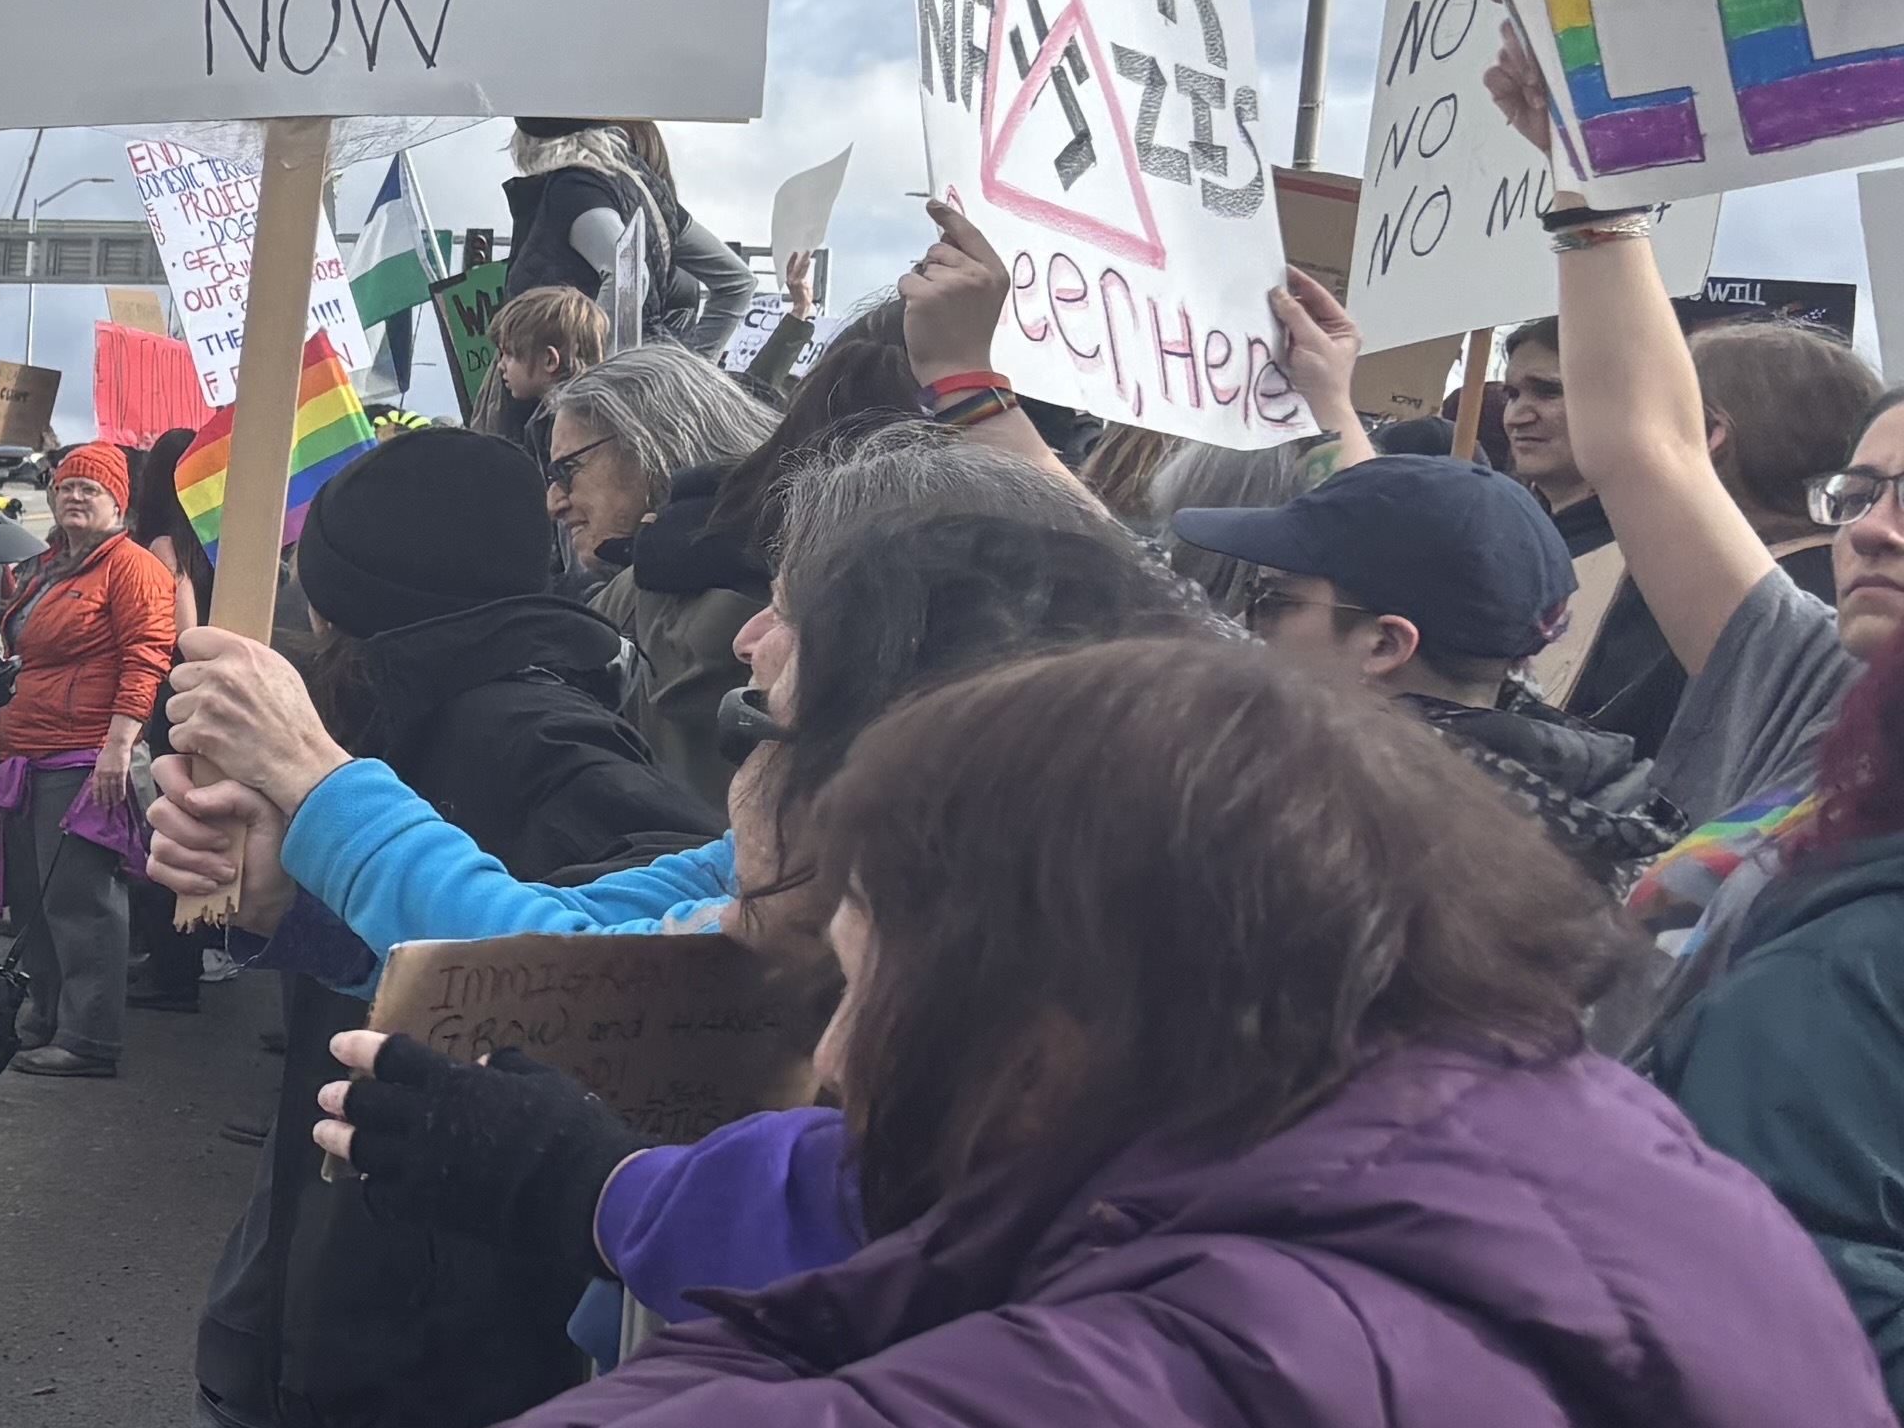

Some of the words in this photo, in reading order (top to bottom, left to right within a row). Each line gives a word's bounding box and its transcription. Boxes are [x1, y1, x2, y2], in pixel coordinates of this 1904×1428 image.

[128, 143, 183, 174] END
[1375, 93, 1457, 187] NO
[136, 162, 204, 201] DOMESTIC
[179, 176, 262, 225] PROJECT
[1368, 184, 1452, 287] NO
[183, 243, 226, 271] GET
[184, 285, 223, 312] OUT
[1707, 282, 1766, 306] WILL
[1147, 297, 1300, 426] Here
